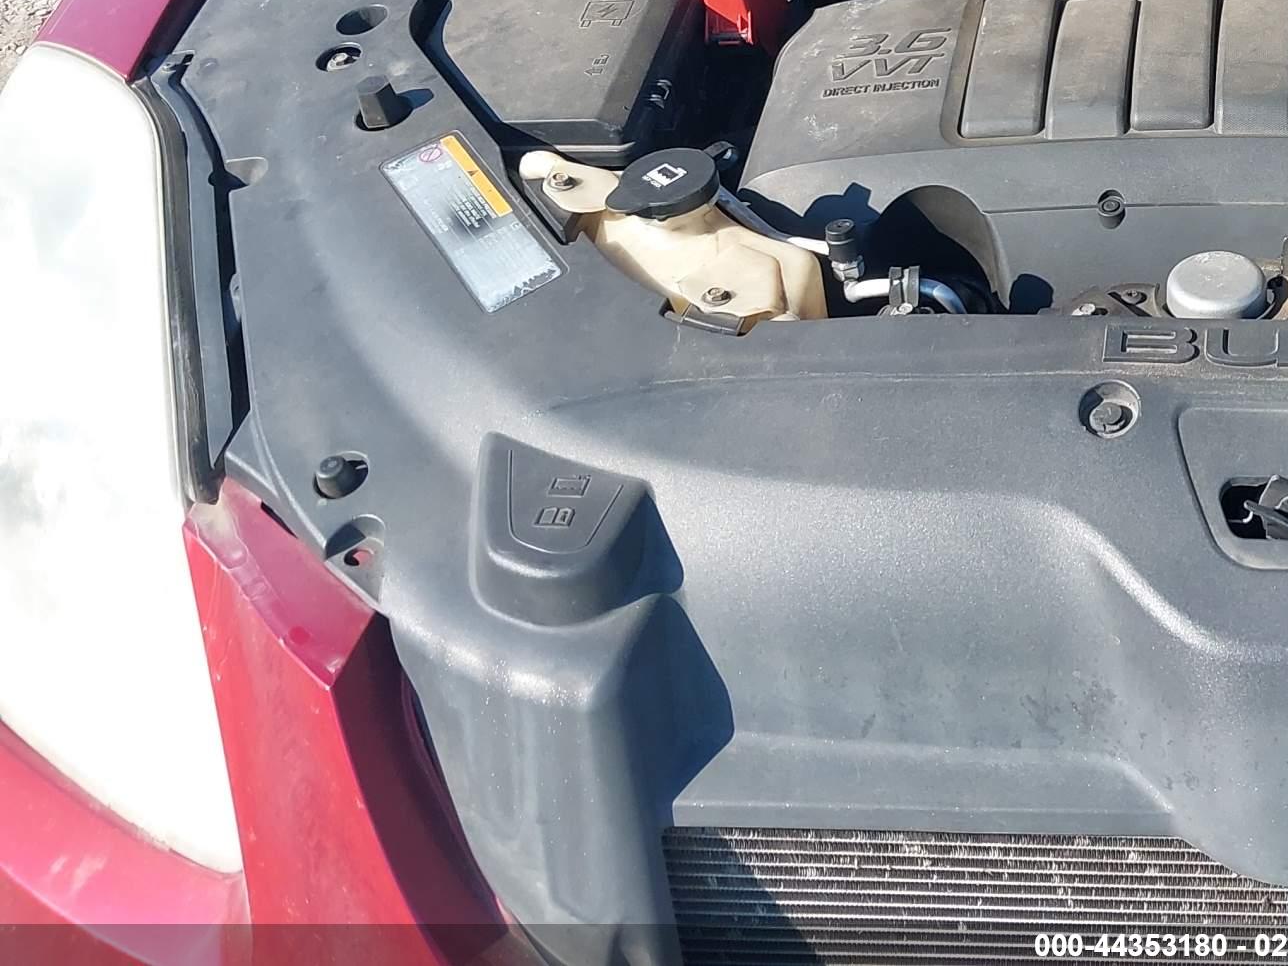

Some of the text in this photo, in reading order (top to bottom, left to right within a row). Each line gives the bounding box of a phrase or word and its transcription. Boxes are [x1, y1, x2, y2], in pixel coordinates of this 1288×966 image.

[832, 27, 952, 59] 3.6
[831, 52, 945, 81] VVT
[822, 78, 940, 98] DIRECT INJECTION
